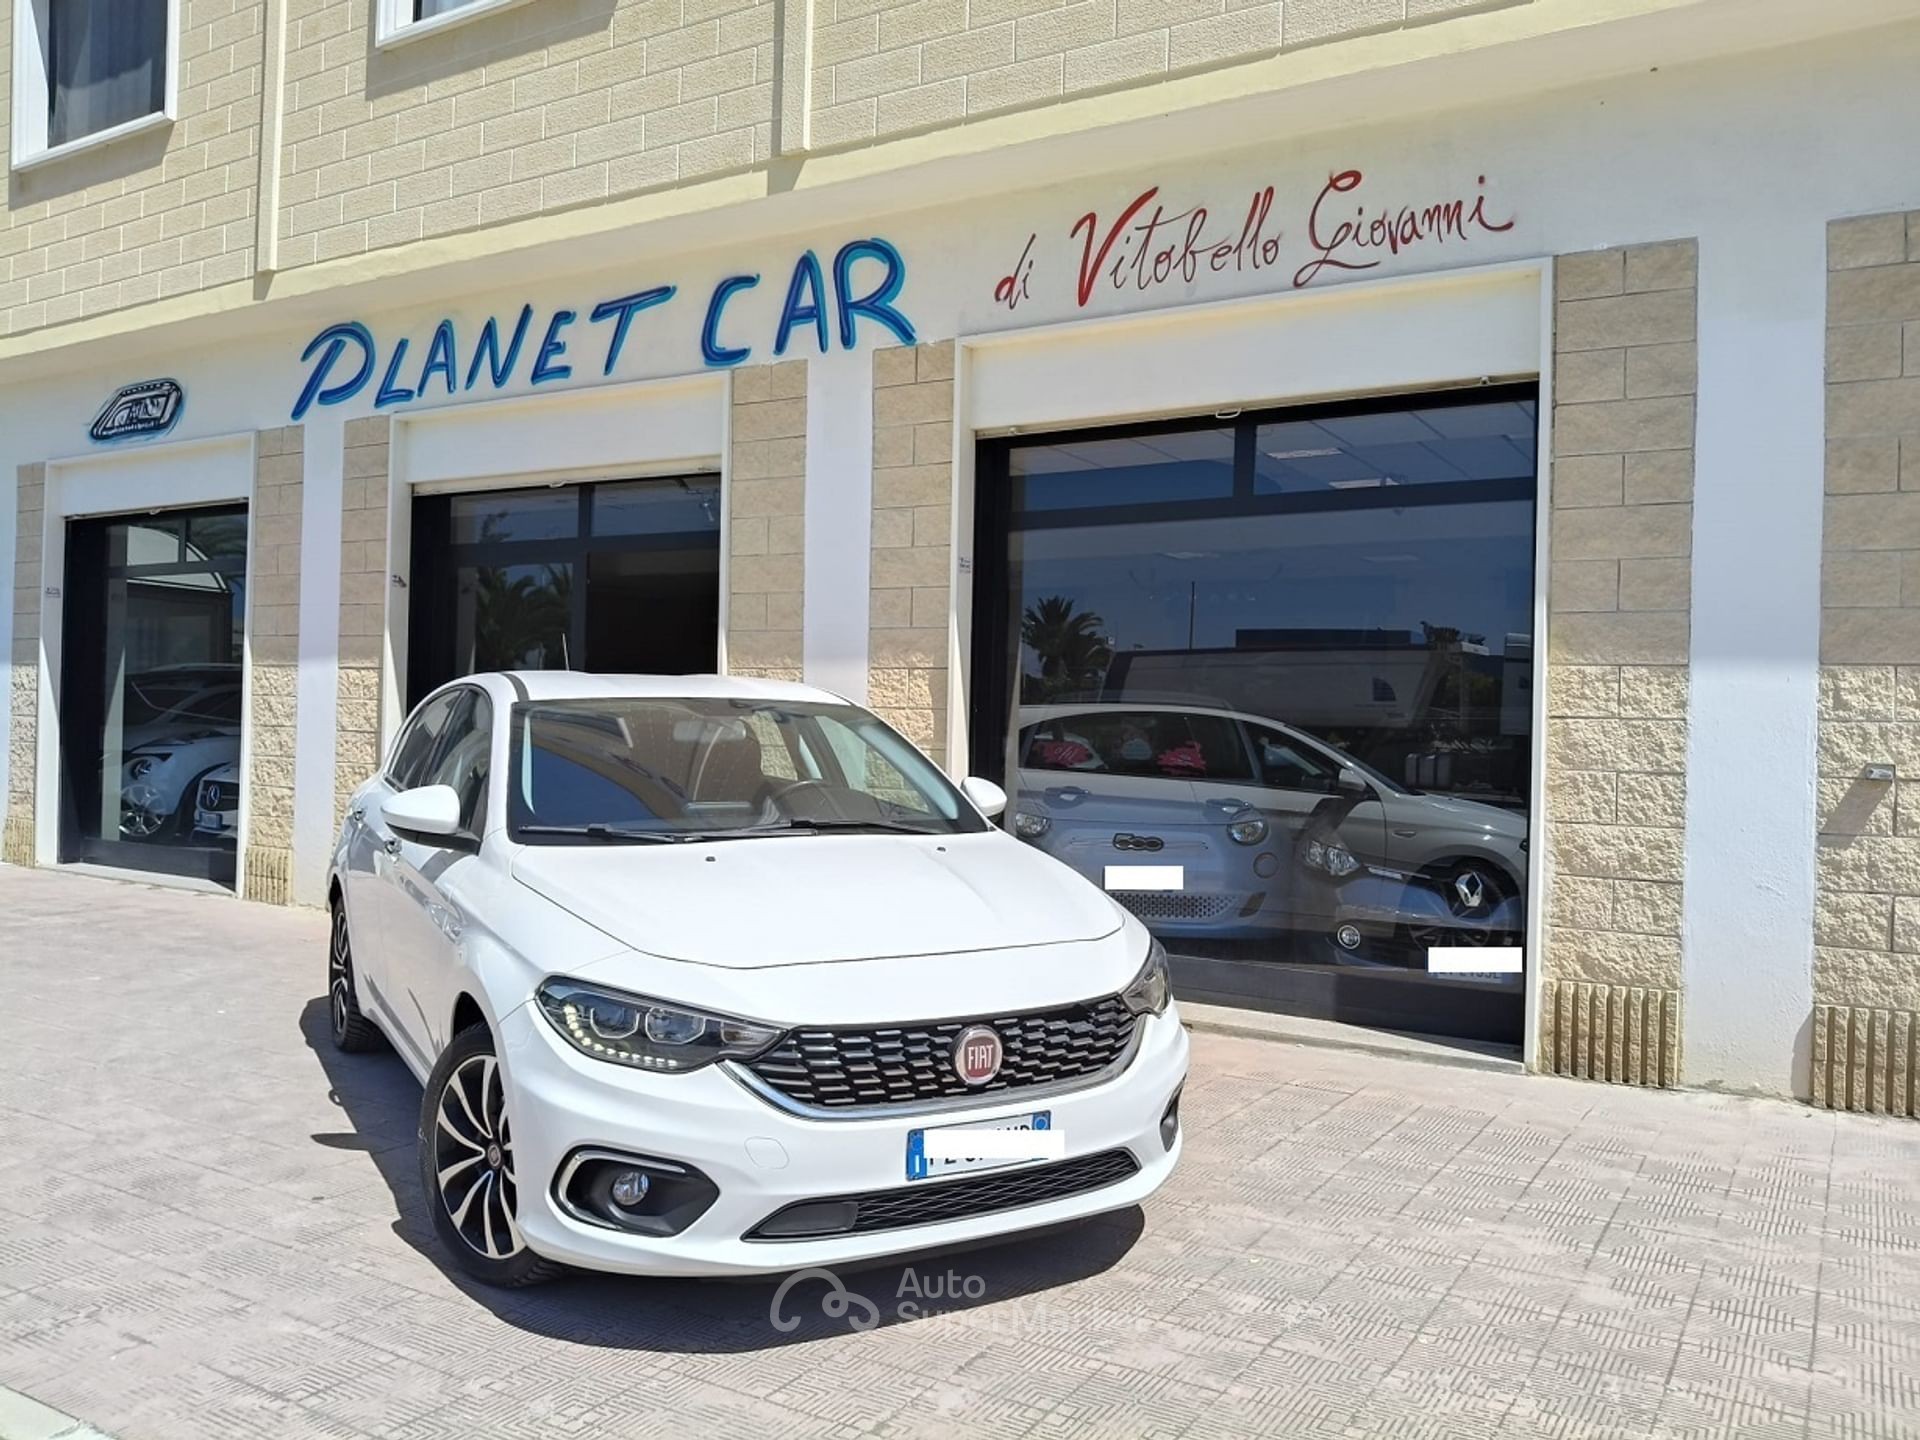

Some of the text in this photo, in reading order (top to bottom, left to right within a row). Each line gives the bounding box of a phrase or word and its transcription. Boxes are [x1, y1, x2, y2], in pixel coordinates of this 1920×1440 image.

[995, 169, 1514, 310] di Vitobello Giovanni
[291, 237, 917, 421] PLANET CAR
[967, 1044, 994, 1071] FIAT
